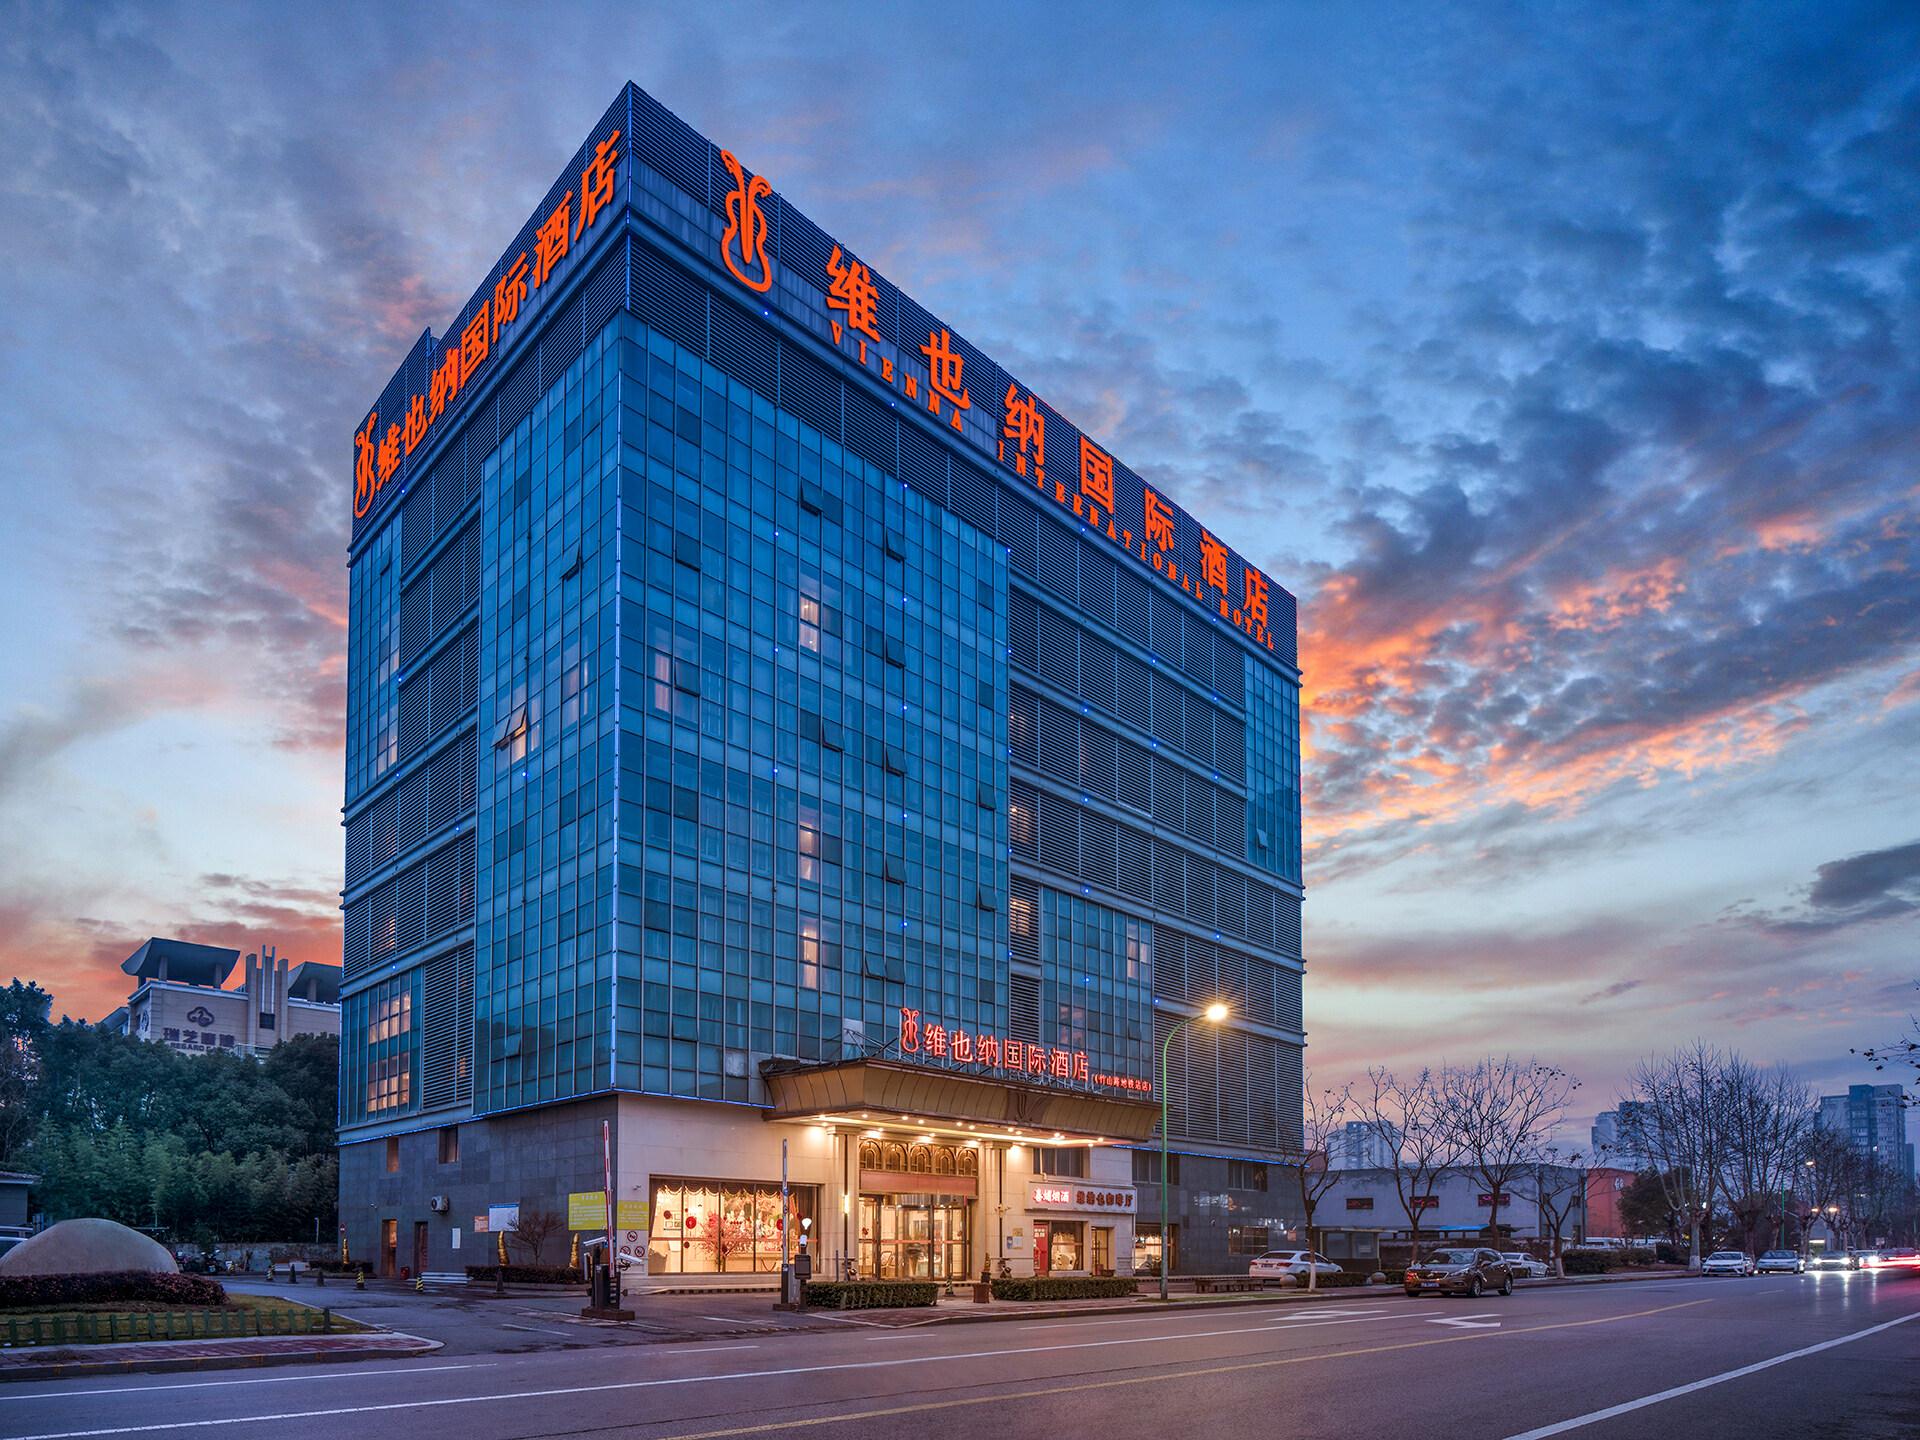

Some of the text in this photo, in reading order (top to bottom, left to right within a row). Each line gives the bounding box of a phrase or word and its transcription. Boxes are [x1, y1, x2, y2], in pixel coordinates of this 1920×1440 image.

[376, 130, 621, 491] 维也纳国际酒店
[830, 320, 964, 433] VIENNA
[826, 246, 1270, 627] 维也纳国际酒店
[996, 440, 1275, 650] INTERNATIONAL HOTEL
[923, 1023, 1089, 1082] 维也纳国际酒店
